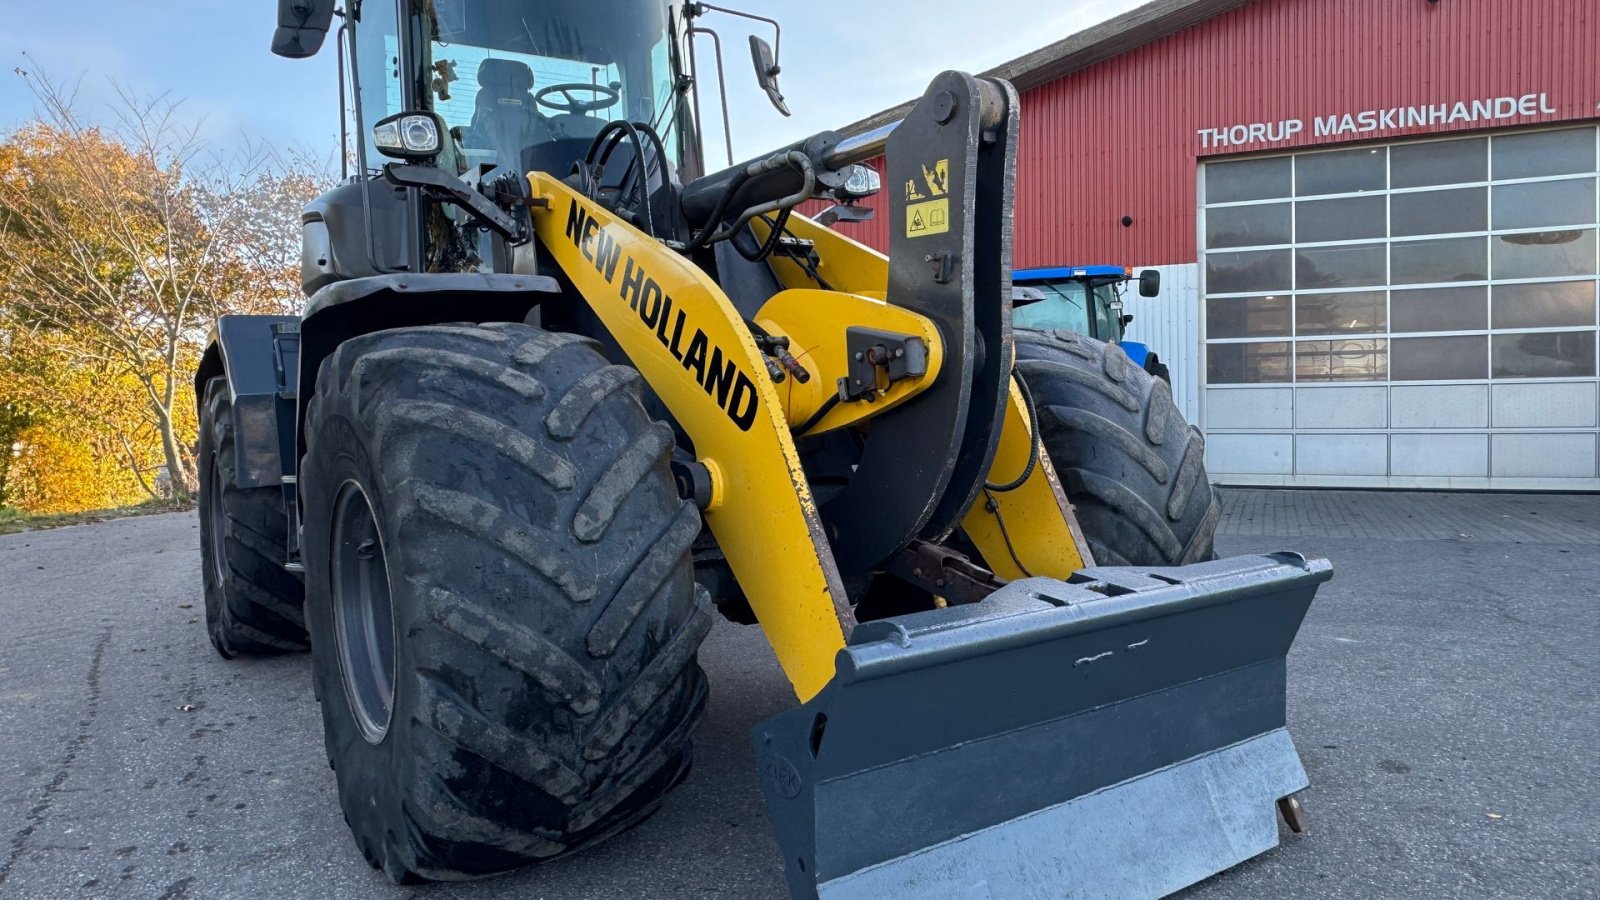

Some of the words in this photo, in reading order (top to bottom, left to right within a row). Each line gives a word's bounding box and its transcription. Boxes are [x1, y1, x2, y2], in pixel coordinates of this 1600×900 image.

[1197, 119, 1303, 149] THORUP
[1314, 92, 1557, 137] MASKINHANDEL
[565, 197, 622, 284] NEW
[619, 255, 759, 432] HOLLAND
